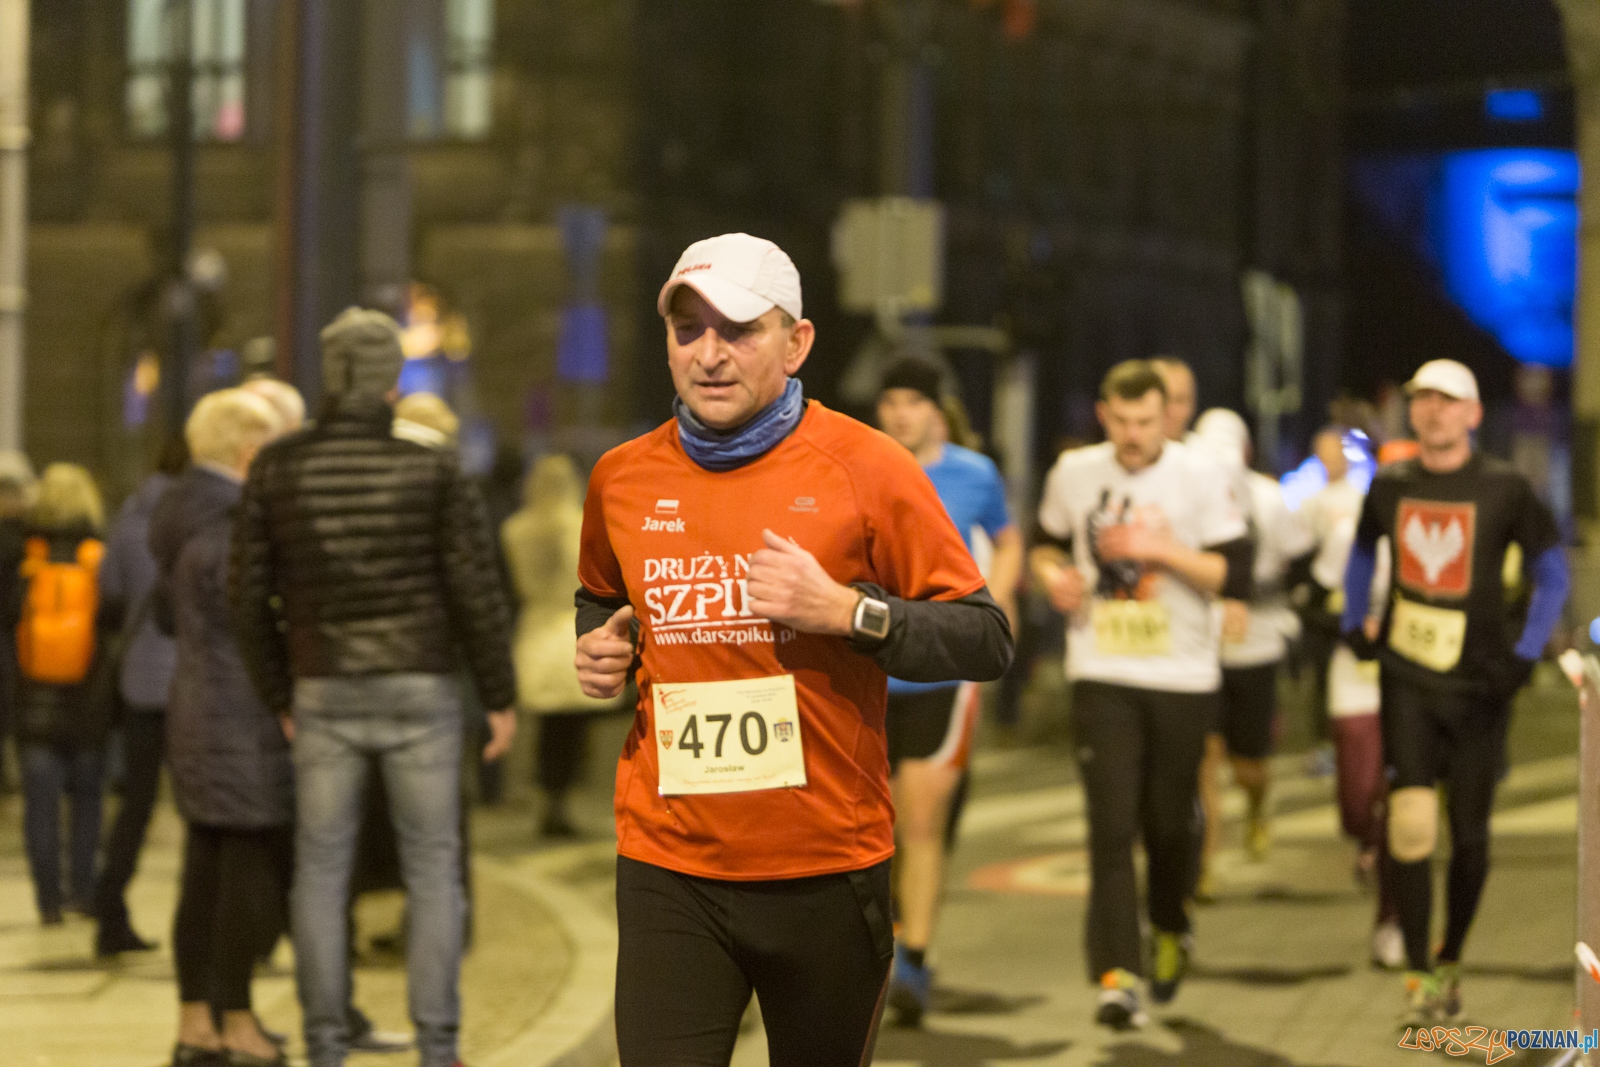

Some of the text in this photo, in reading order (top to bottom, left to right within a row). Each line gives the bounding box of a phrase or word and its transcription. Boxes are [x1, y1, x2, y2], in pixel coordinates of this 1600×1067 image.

[641, 516, 686, 533] Jarek
[643, 551, 753, 582] DRUŻYN
[654, 626, 797, 646] www.darszpikupl
[678, 711, 768, 759] 470
[704, 764, 745, 774] Jarosław
